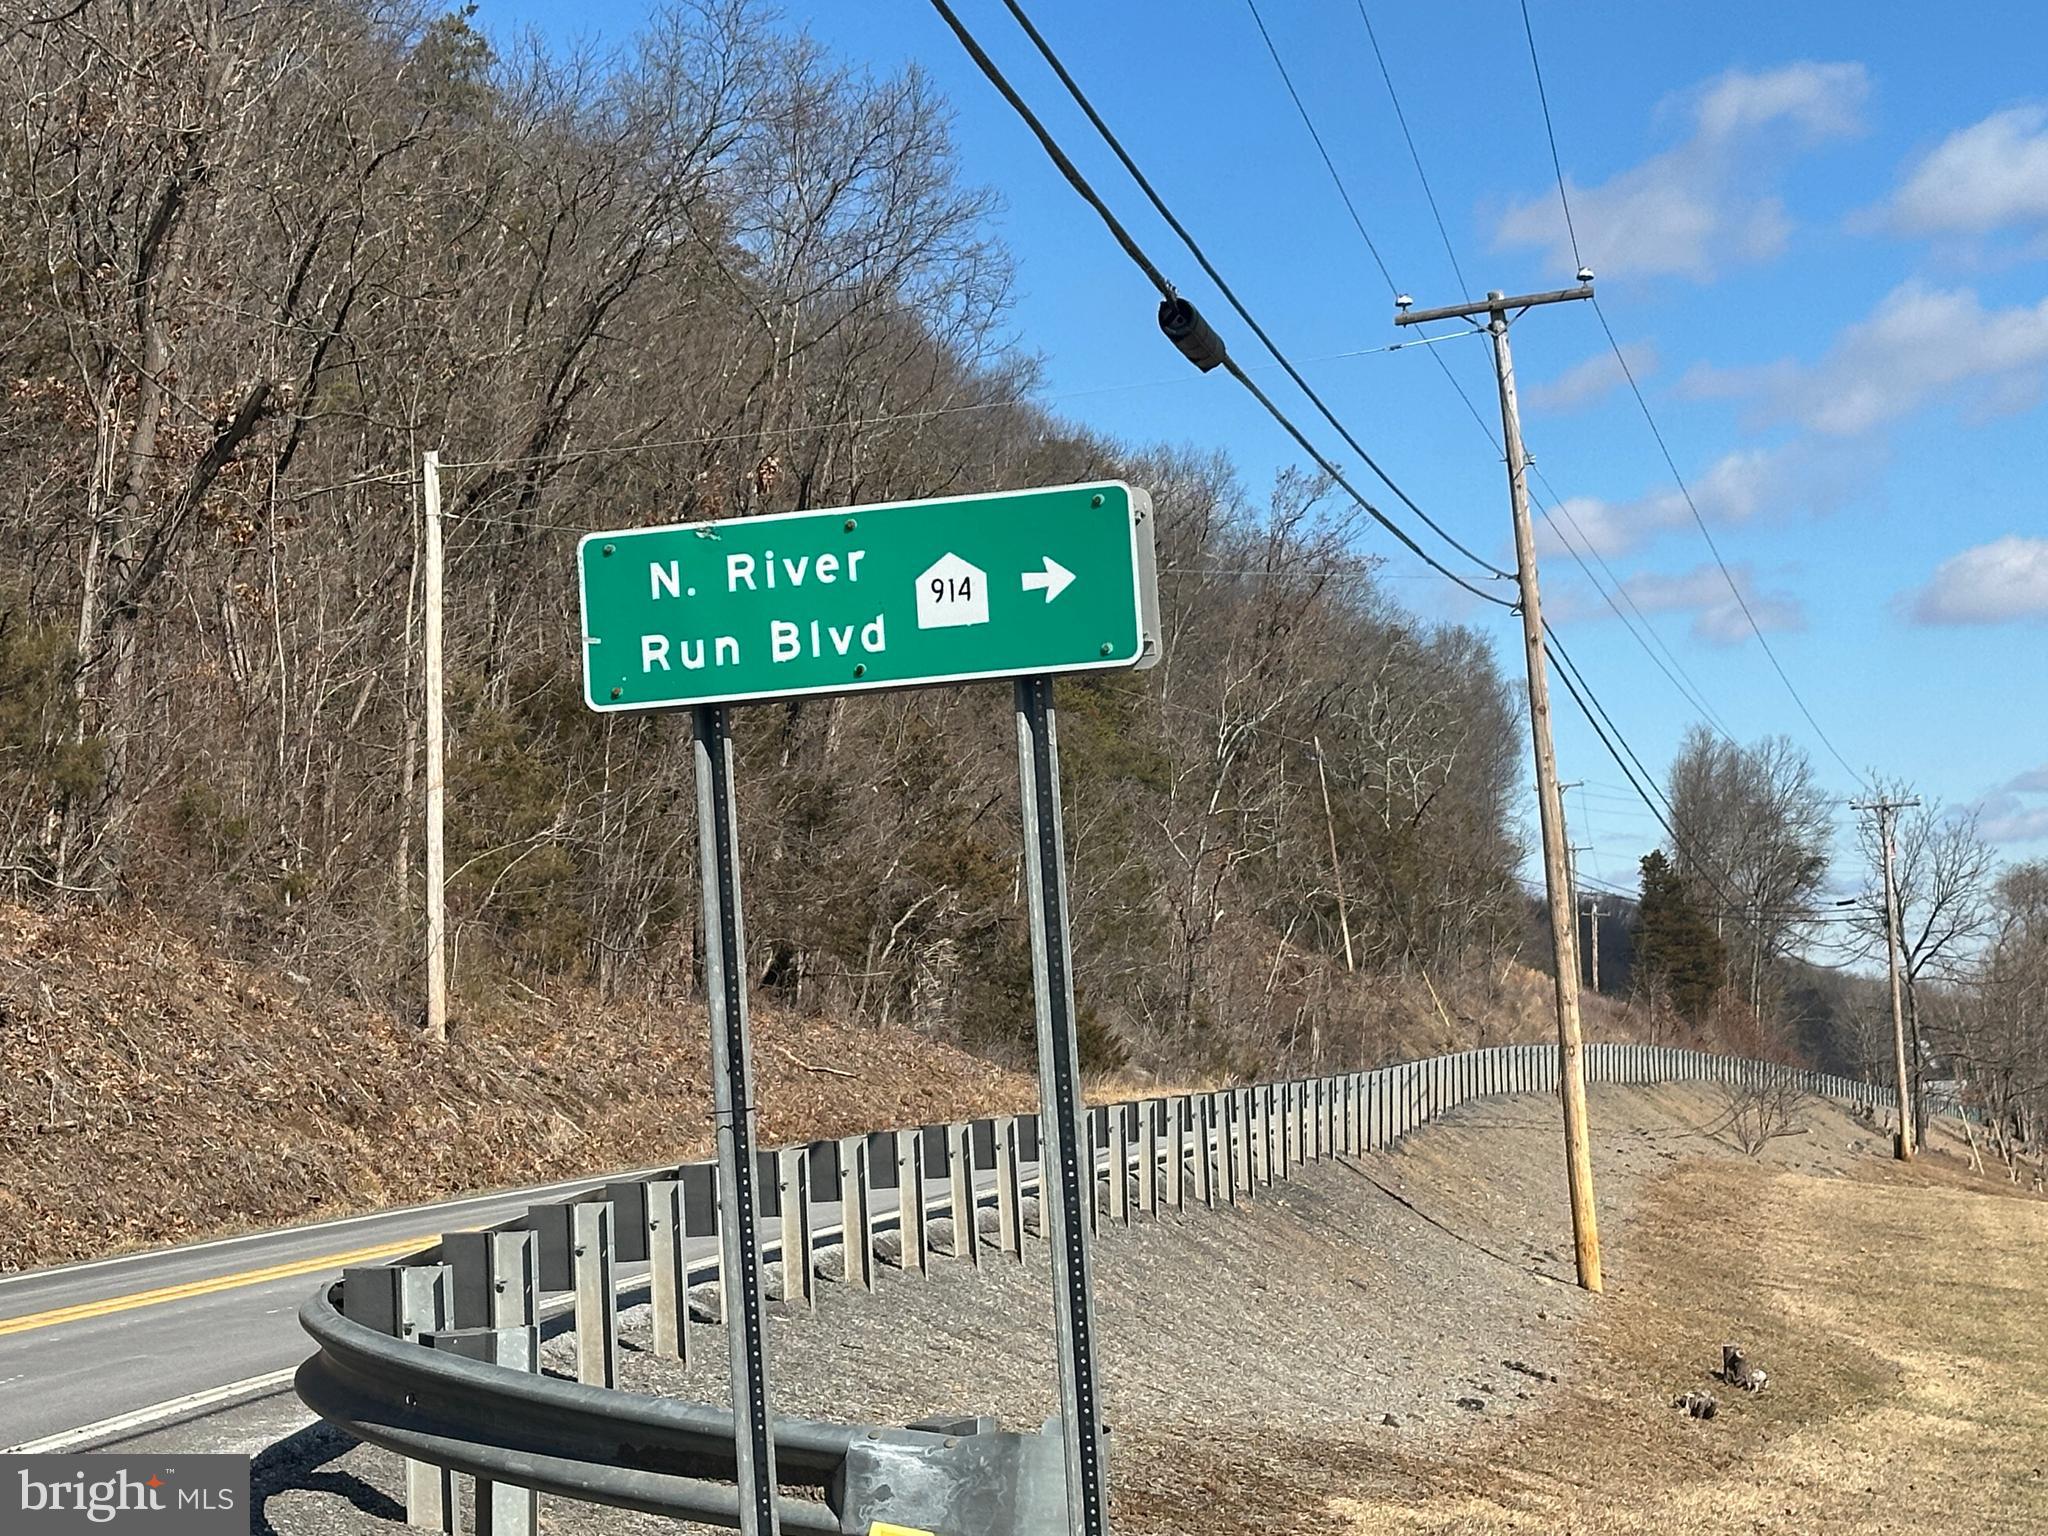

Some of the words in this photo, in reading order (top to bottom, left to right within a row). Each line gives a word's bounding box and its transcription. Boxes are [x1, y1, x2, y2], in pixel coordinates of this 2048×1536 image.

[650, 560, 697, 600] N.
[726, 549, 866, 593] River
[930, 576, 973, 603] 914
[640, 631, 740, 673] Run
[770, 613, 886, 663] Blvd
